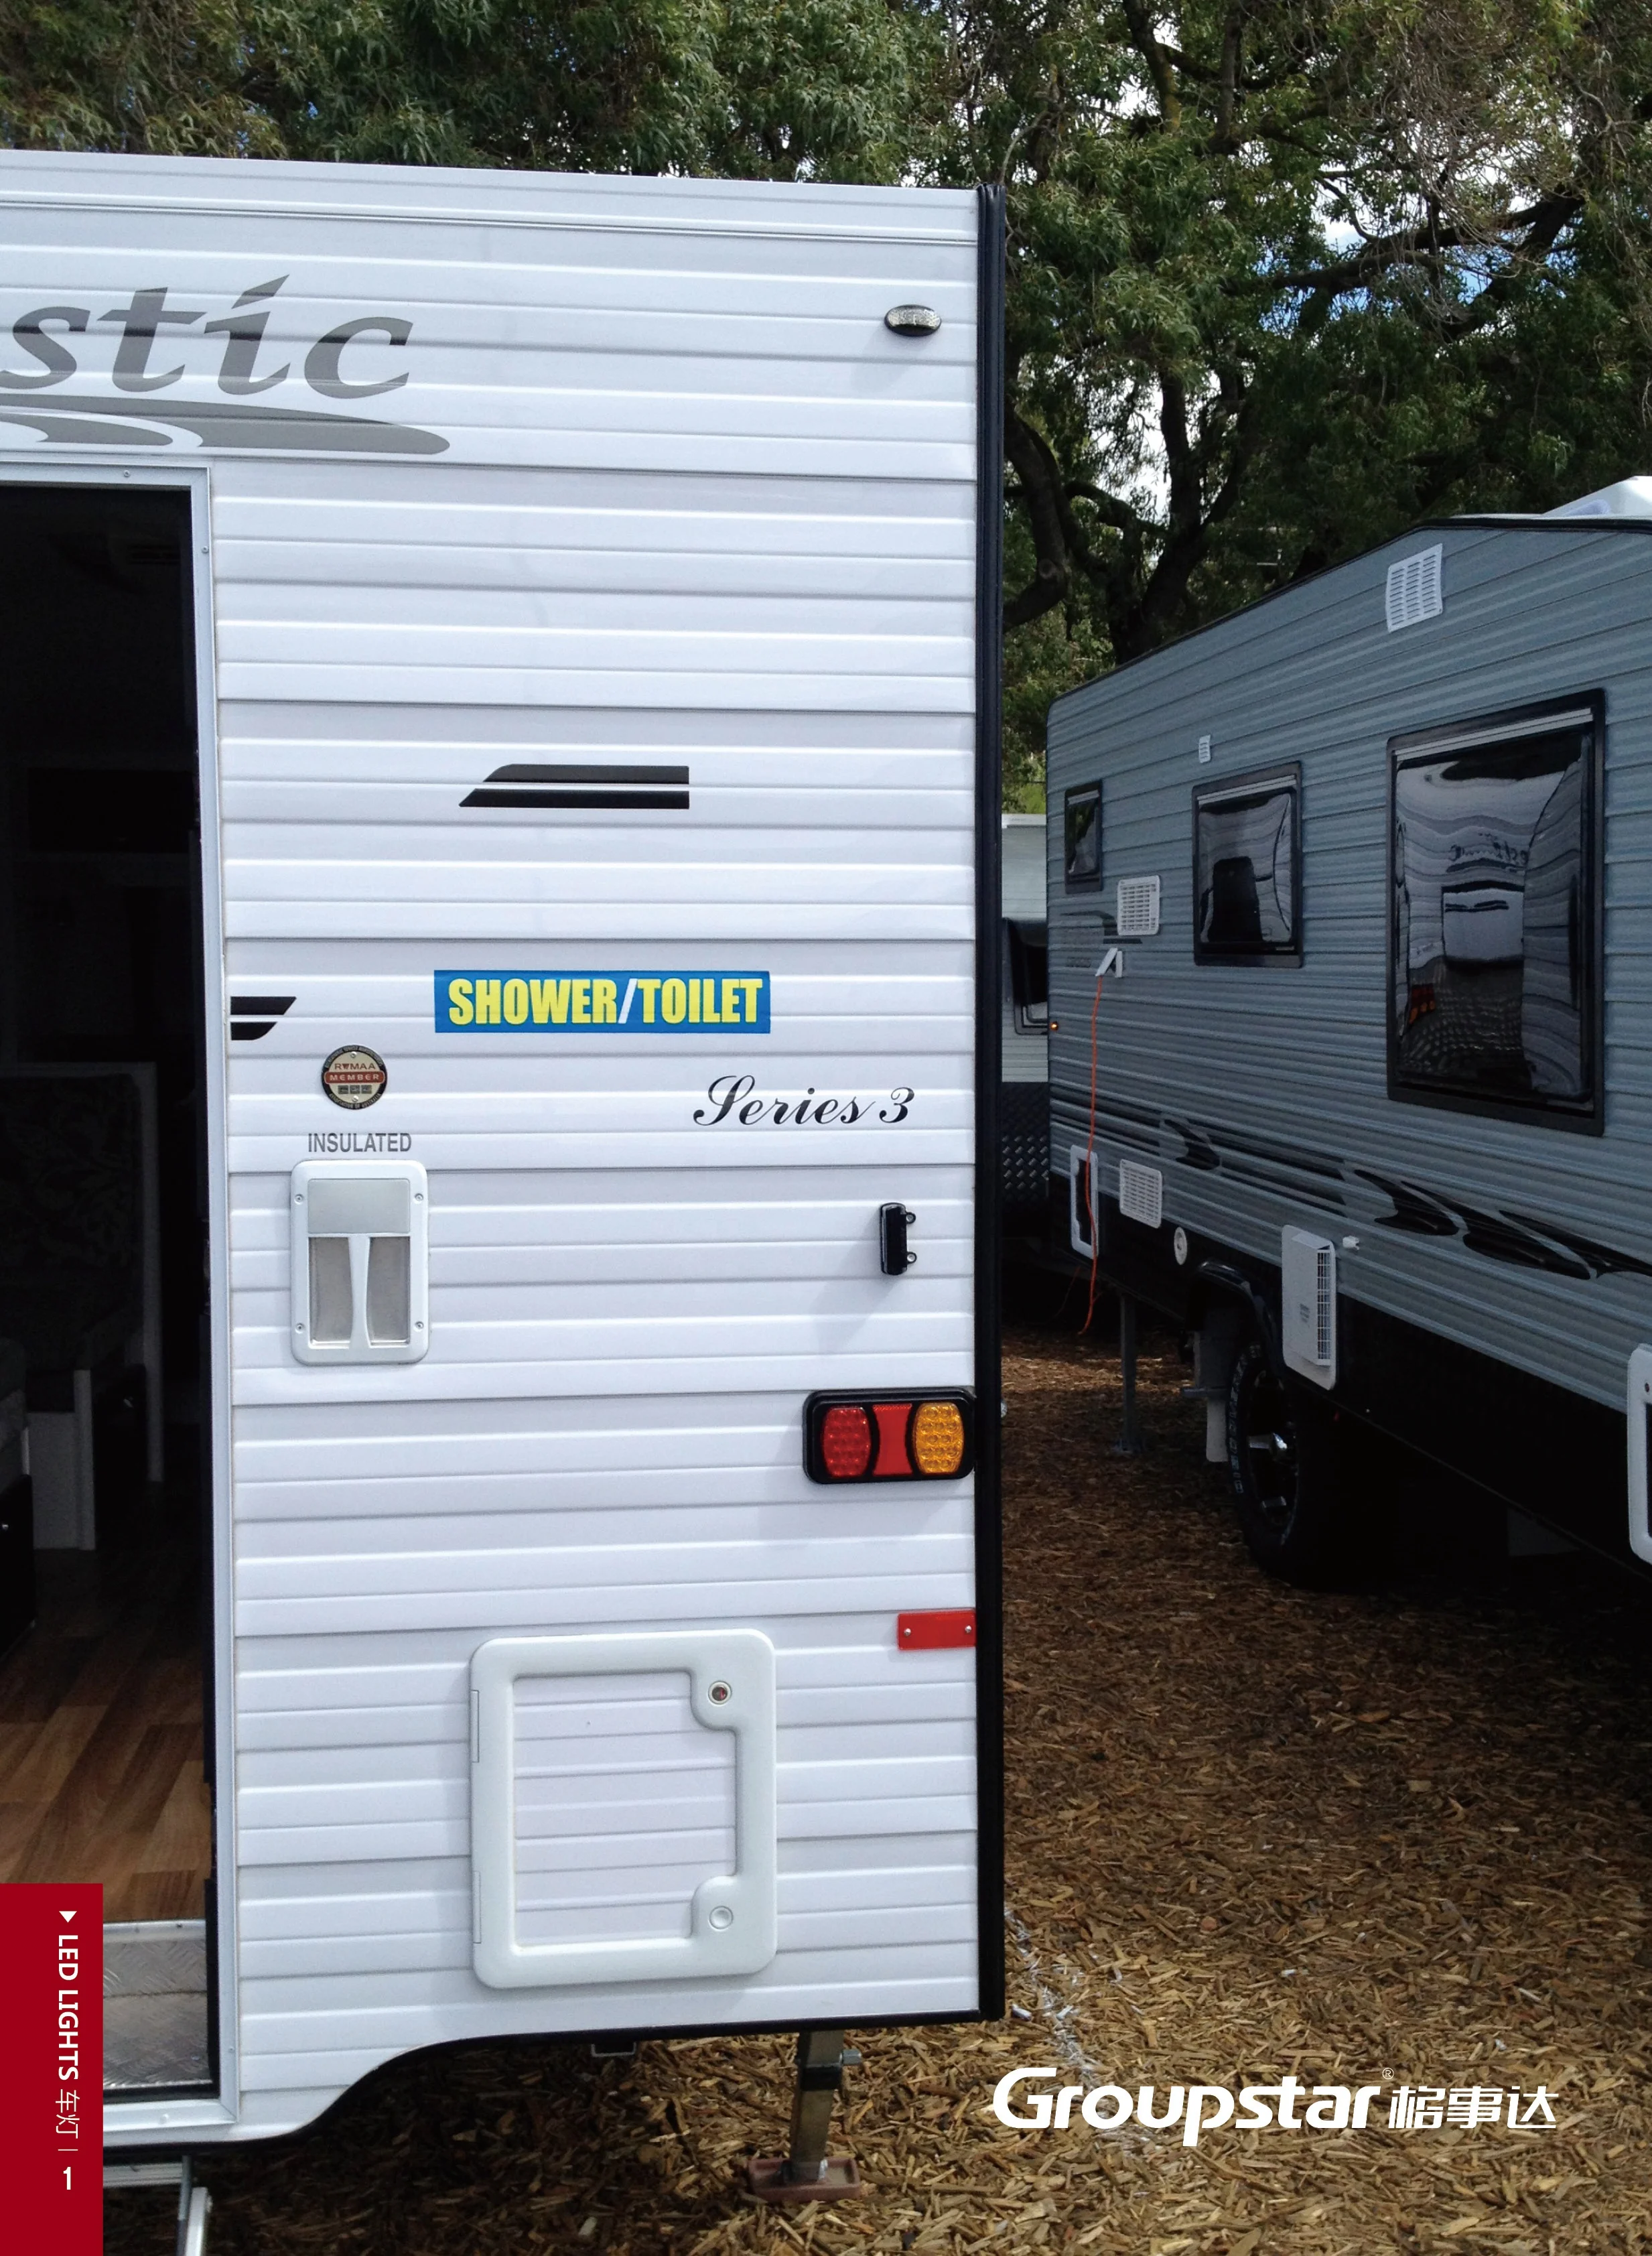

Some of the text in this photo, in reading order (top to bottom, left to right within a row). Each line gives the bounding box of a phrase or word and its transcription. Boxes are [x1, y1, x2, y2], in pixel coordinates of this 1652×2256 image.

[448, 978, 763, 1024] SHOWER/TOILET
[692, 1075, 915, 1127] Series 3
[308, 1133, 412, 1152] INSULATED
